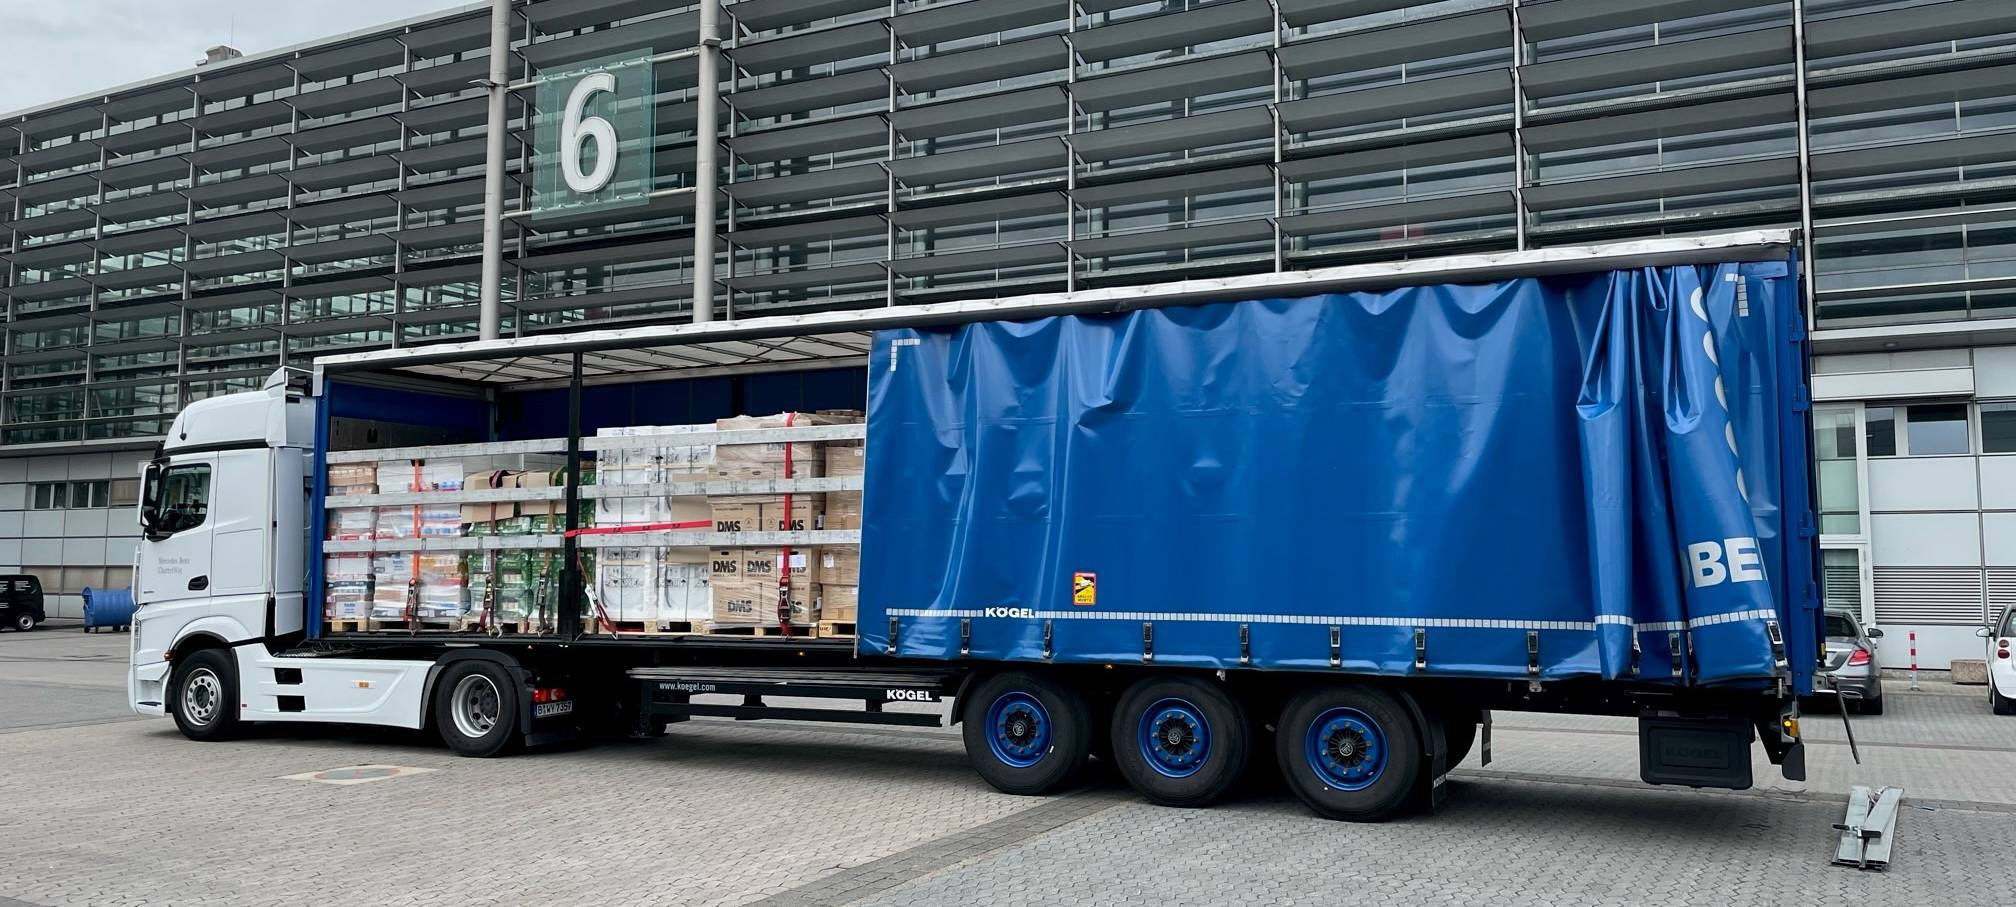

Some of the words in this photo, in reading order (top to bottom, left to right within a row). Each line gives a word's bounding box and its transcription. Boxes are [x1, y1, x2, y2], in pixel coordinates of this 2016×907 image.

[561, 72, 618, 193] 6
[717, 521, 741, 533] DMS
[713, 560, 737, 573] DMS
[747, 560, 772, 573] DMS
[727, 600, 752, 613] DMS
[985, 606, 1035, 619] KÖGEL
[659, 681, 716, 692] www.koegel.com
[886, 689, 933, 701] KÖGEL
